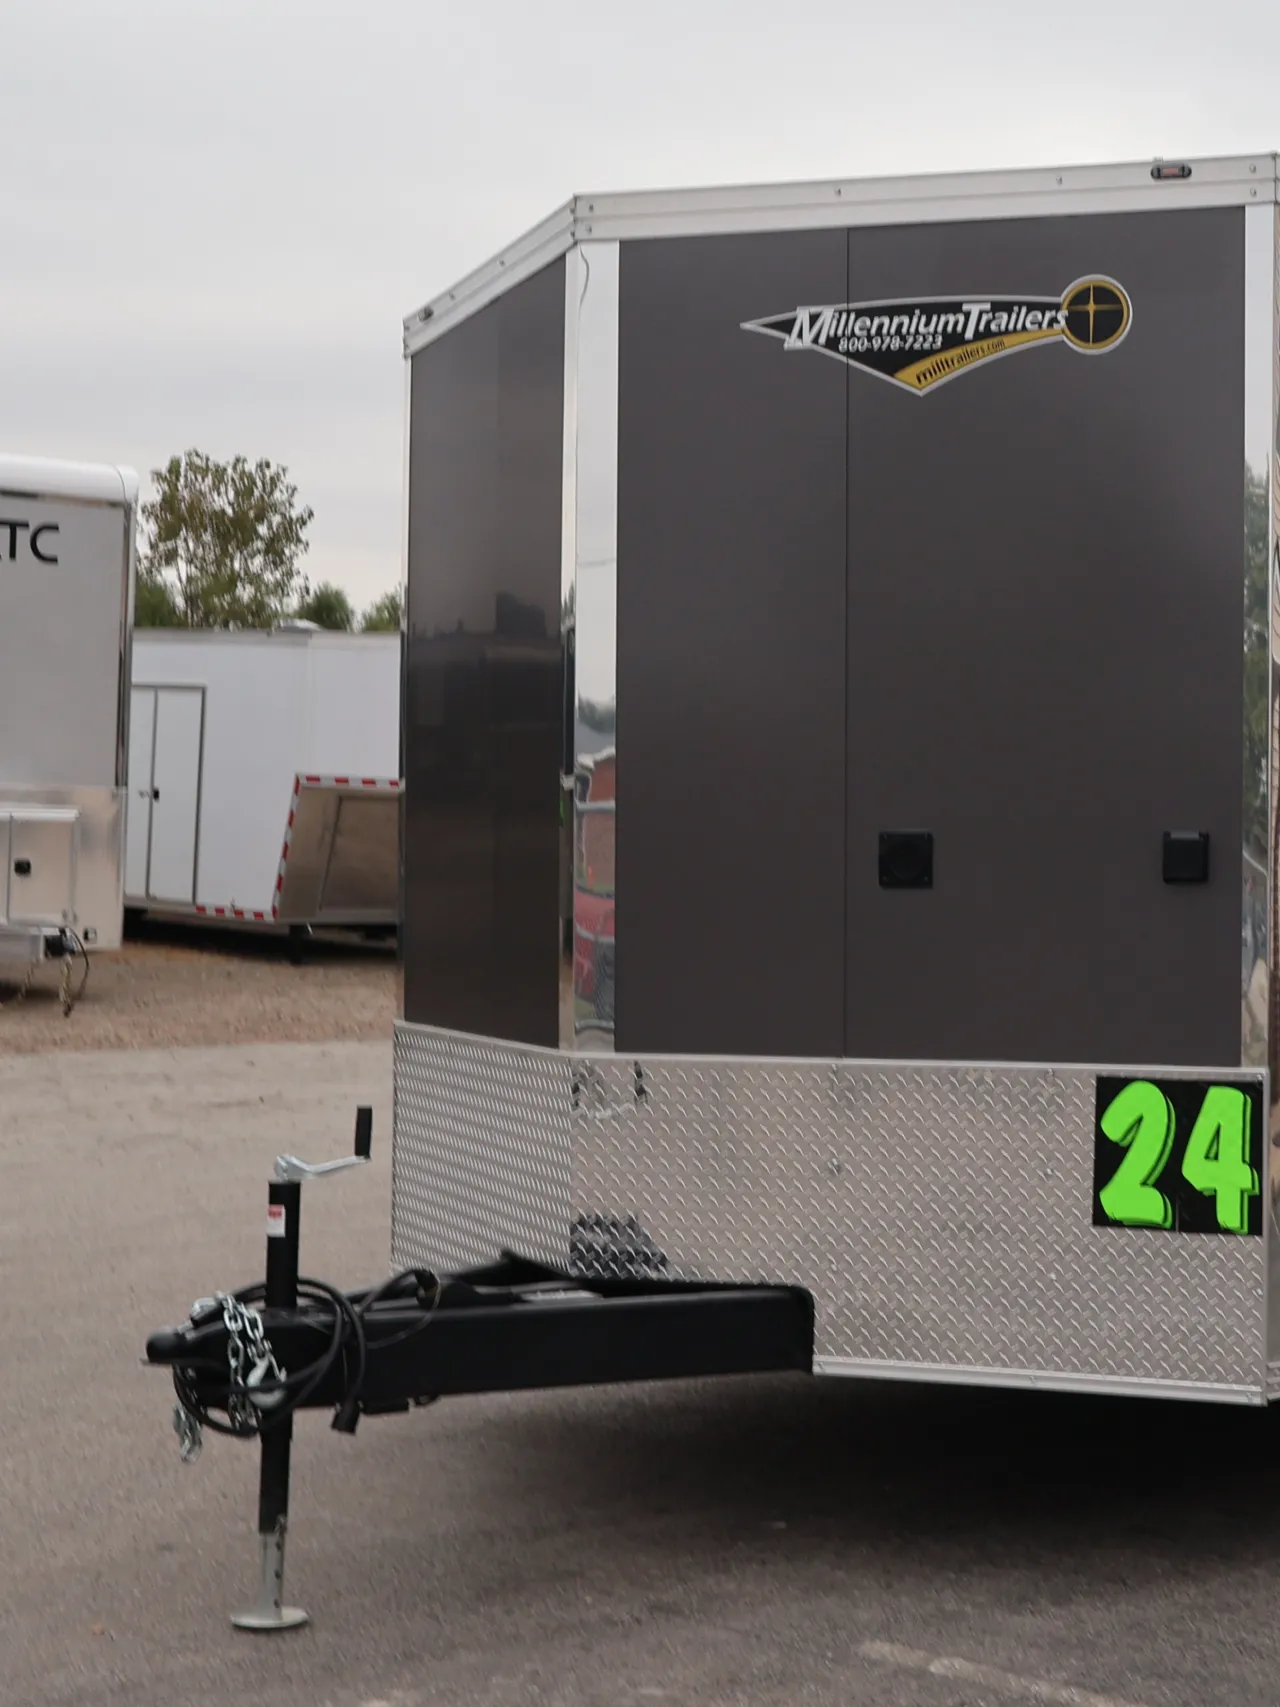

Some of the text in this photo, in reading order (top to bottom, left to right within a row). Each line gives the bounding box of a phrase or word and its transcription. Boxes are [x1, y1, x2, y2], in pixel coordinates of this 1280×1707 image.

[915, 338, 1006, 385] milltrailers.com
[0, 519, 59, 566] TC
[1100, 1080, 1259, 1234] 24
